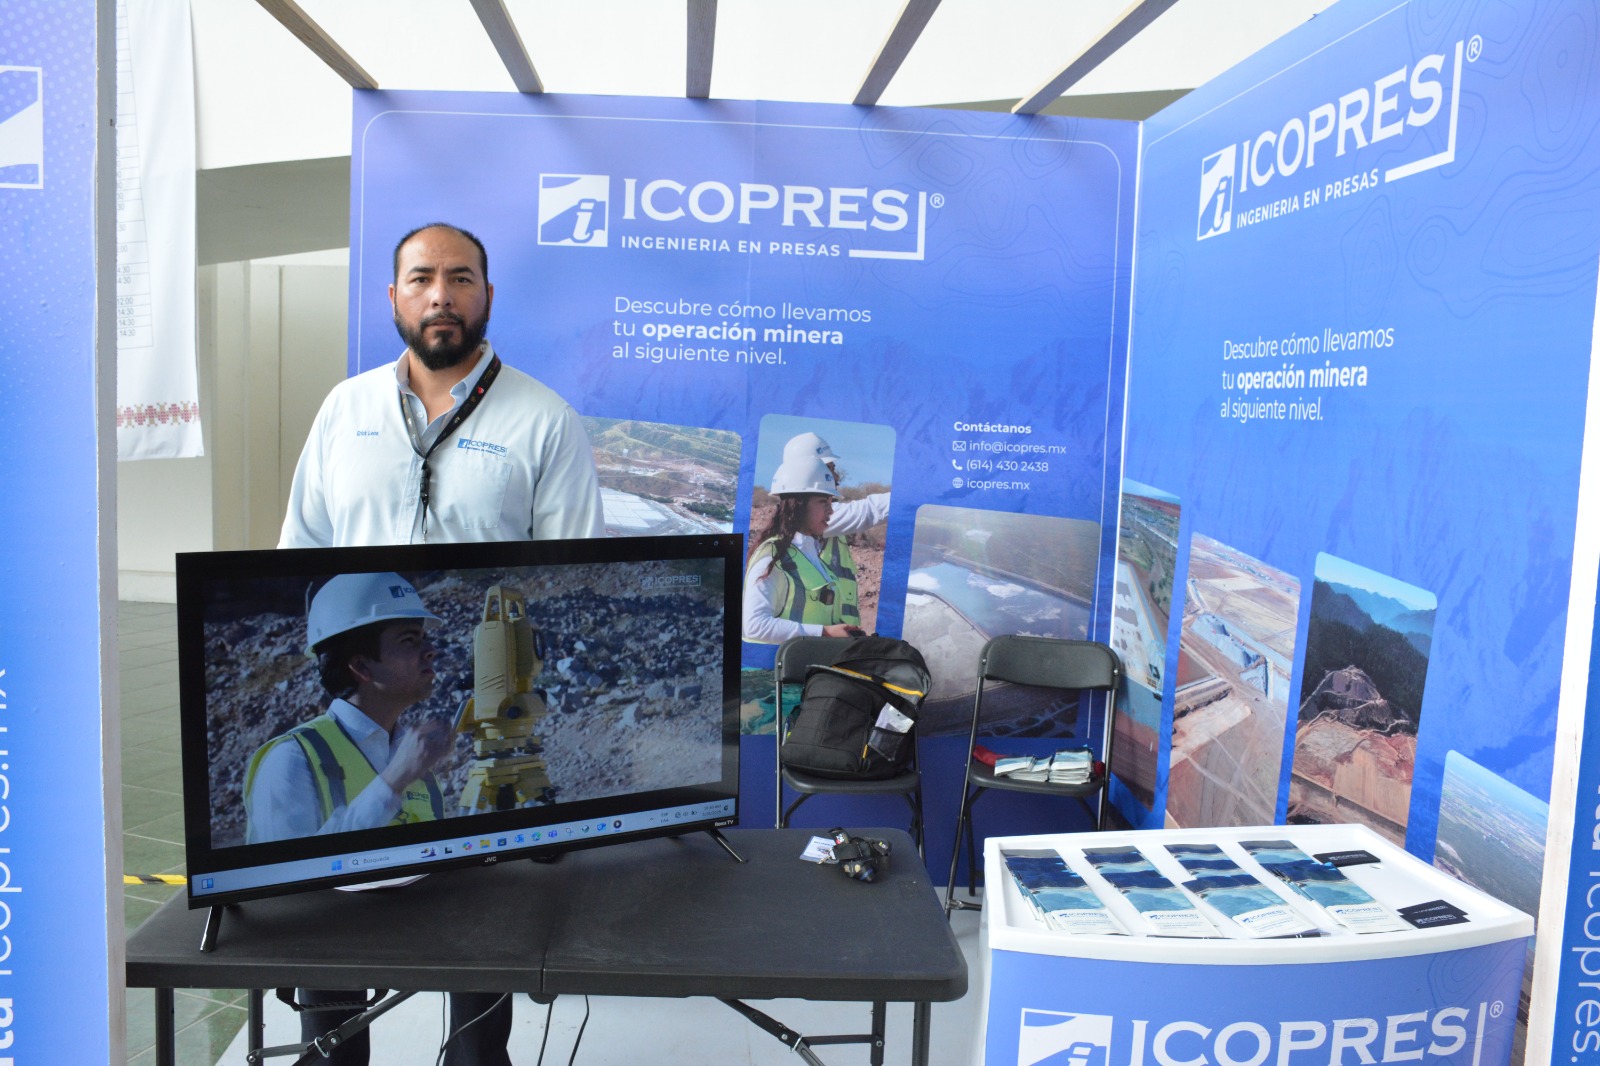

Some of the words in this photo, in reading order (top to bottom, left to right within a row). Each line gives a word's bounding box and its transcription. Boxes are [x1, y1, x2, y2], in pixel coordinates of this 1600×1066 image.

[1239, 54, 1446, 193] ICOPRES
[622, 177, 910, 232] ICOPRES
[1236, 195, 1300, 230] INGENIERIA
[1303, 187, 1320, 208] EN
[1325, 168, 1379, 202] PRESAS
[621, 235, 731, 253] INGENIERIA
[738, 240, 762, 254] EN
[769, 242, 841, 257] PRESAS
[614, 296, 713, 318] Descubre
[718, 299, 777, 320] cómo
[782, 302, 872, 324] llevamos
[120, 329, 136, 337] 14:30
[612, 320, 636, 337] tu
[642, 320, 757, 345] operación
[764, 324, 844, 346] minera
[1223, 335, 1279, 361] Descubre
[1280, 332, 1320, 357] cómo
[1323, 327, 1395, 352] llevamos
[612, 342, 629, 360] al
[634, 344, 730, 367] siguiente
[735, 347, 788, 366] nivel.
[1222, 371, 1235, 390] tu
[1237, 363, 1305, 395] operación
[1309, 360, 1368, 388] minera
[1220, 397, 1230, 418] al
[1232, 397, 1286, 424] siguiente
[1289, 396, 1324, 421] nivel.
[953, 421, 1032, 434] Contáctanos
[466, 439, 506, 453] ICOPRES
[969, 440, 1067, 455] info@icopres.mx
[966, 459, 993, 473] (614)
[996, 460, 1018, 471] 430
[1021, 461, 1049, 473] 2438
[966, 478, 1030, 491] icopres.mx
[654, 575, 699, 585] ICOPRES
[1129, 1008, 1470, 1066] ICOPRES
